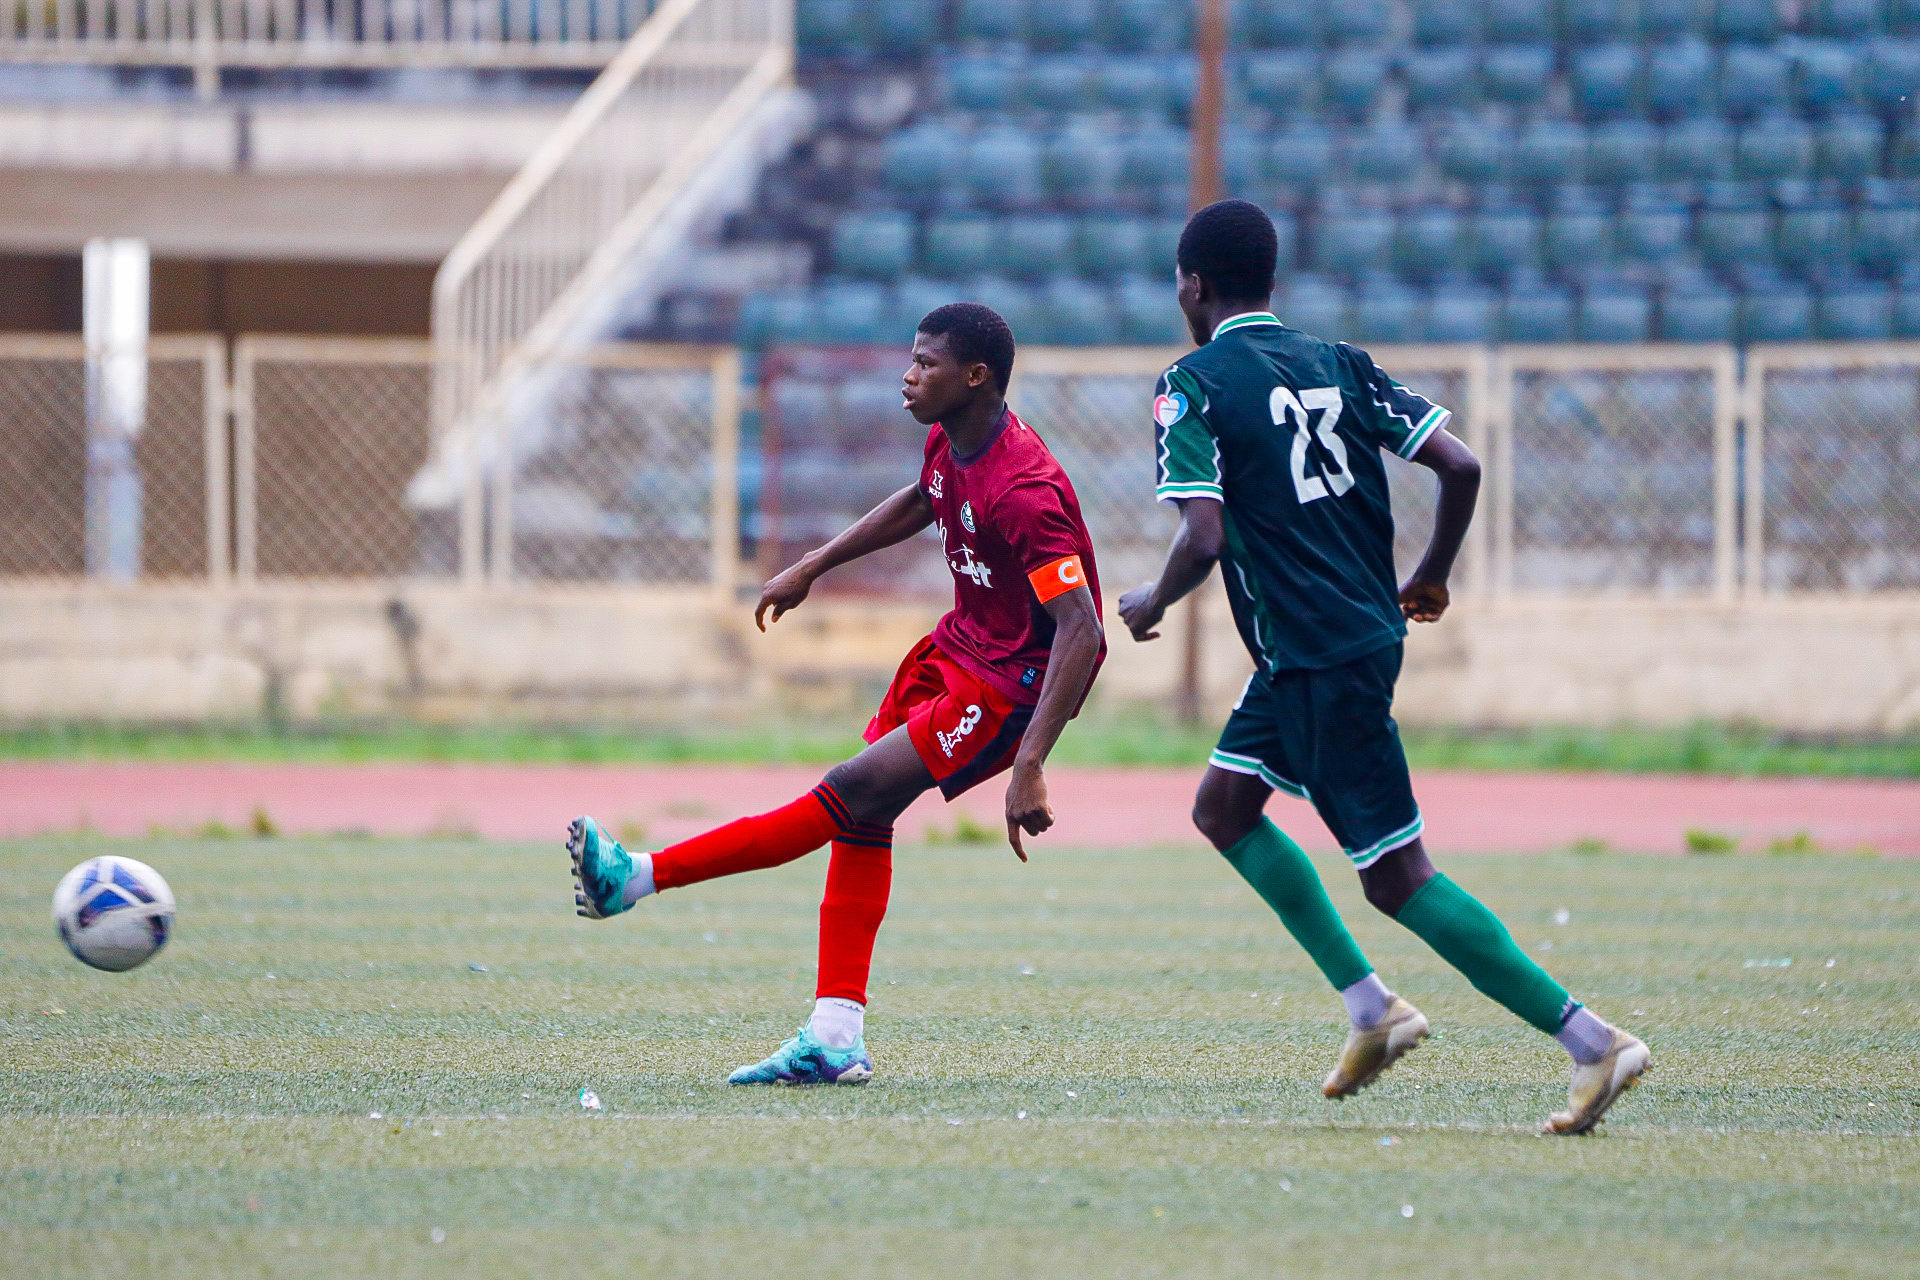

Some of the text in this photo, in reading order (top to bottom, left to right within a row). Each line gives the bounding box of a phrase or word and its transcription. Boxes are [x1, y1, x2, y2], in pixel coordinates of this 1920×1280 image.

[1269, 386, 1355, 504] 23
[1057, 561, 1079, 584] C
[958, 704, 983, 736] 3
